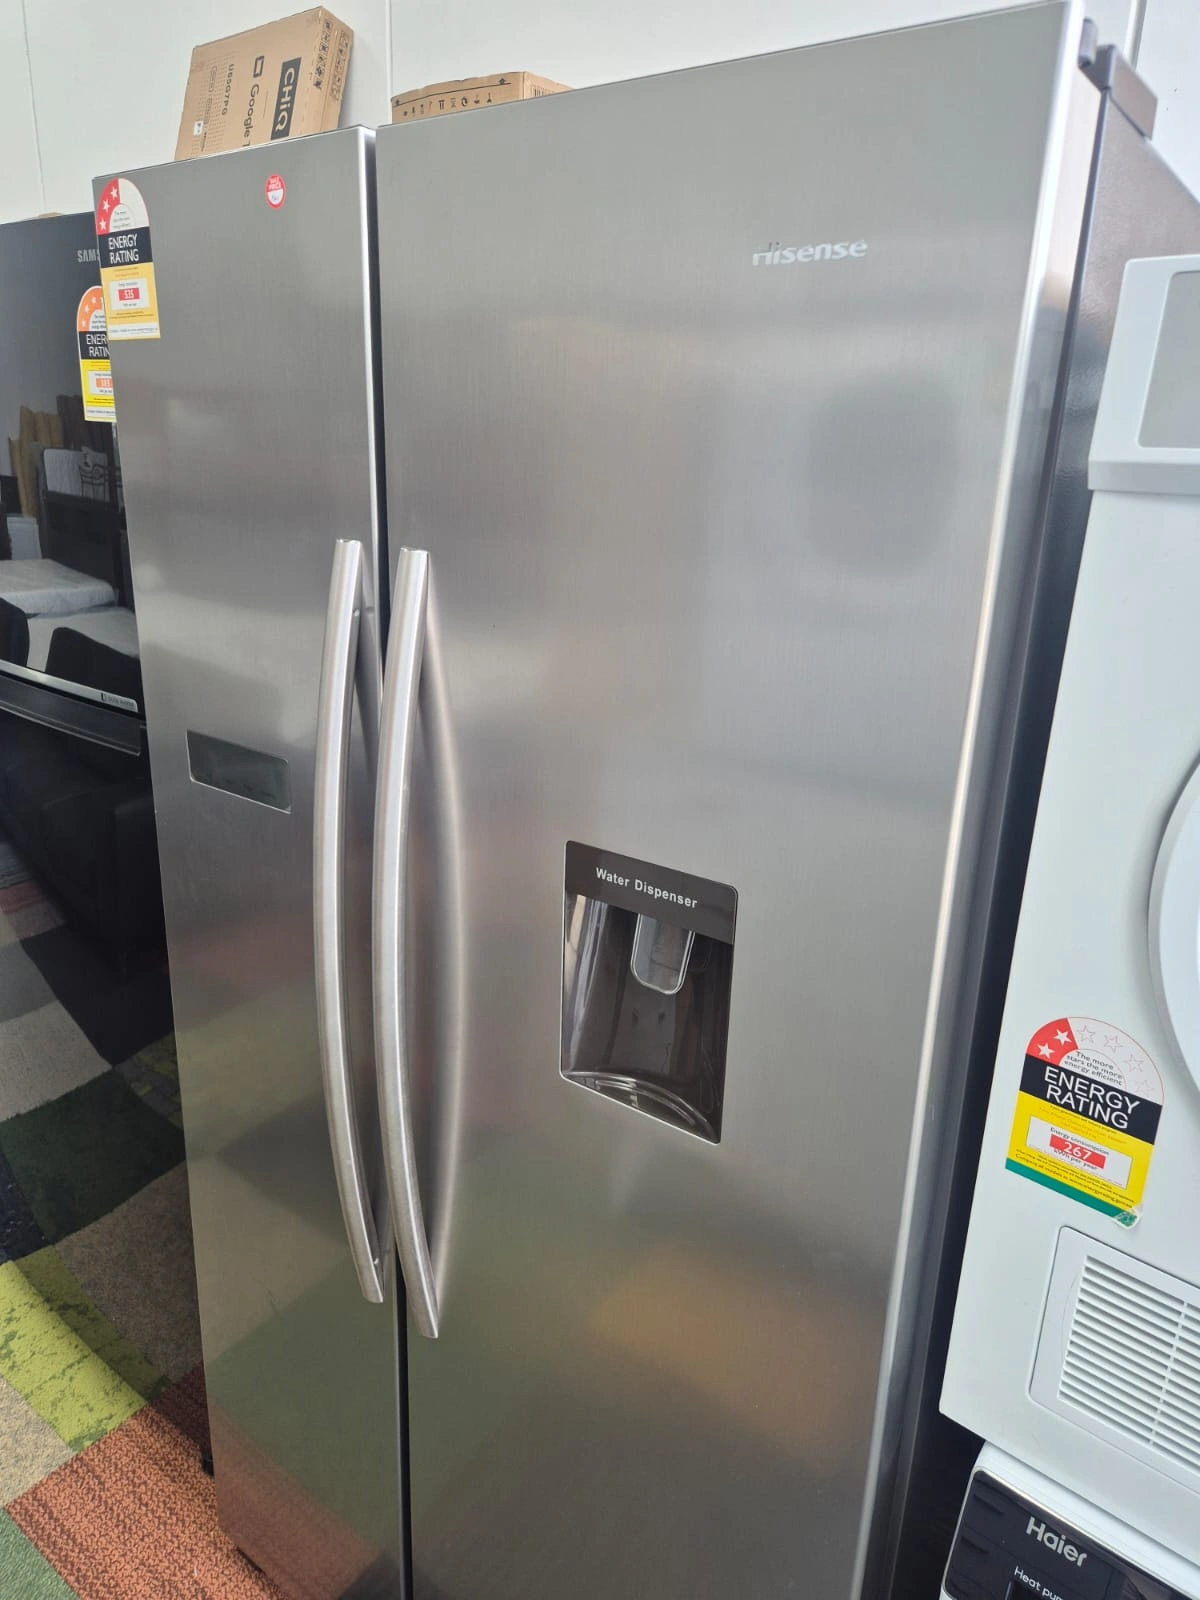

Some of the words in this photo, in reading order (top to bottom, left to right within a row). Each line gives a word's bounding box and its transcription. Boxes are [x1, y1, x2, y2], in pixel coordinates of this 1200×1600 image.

[244, 84, 260, 138] Google
[108, 233, 138, 250] ENERGY
[77, 249, 98, 262] SAM
[110, 249, 139, 264] RATING
[86, 334, 108, 345] ENER
[595, 867, 630, 887] Water
[634, 879, 698, 909] Dispenser
[1077, 1051, 1090, 1061] The
[1093, 1059, 1114, 1070] more
[1064, 1060, 1090, 1073] energy
[1091, 1070, 1122, 1086] efficient
[1087, 1062, 1099, 1071] the
[1101, 1069, 1122, 1079] more
[1044, 1065, 1140, 1115] ENERGY
[1046, 1085, 1129, 1129] RATING
[1050, 1127, 1070, 1140] Energy
[1064, 1141, 1092, 1160] 267
[1026, 1516, 1088, 1567] Haier
[1014, 1566, 1041, 1591] Heat
